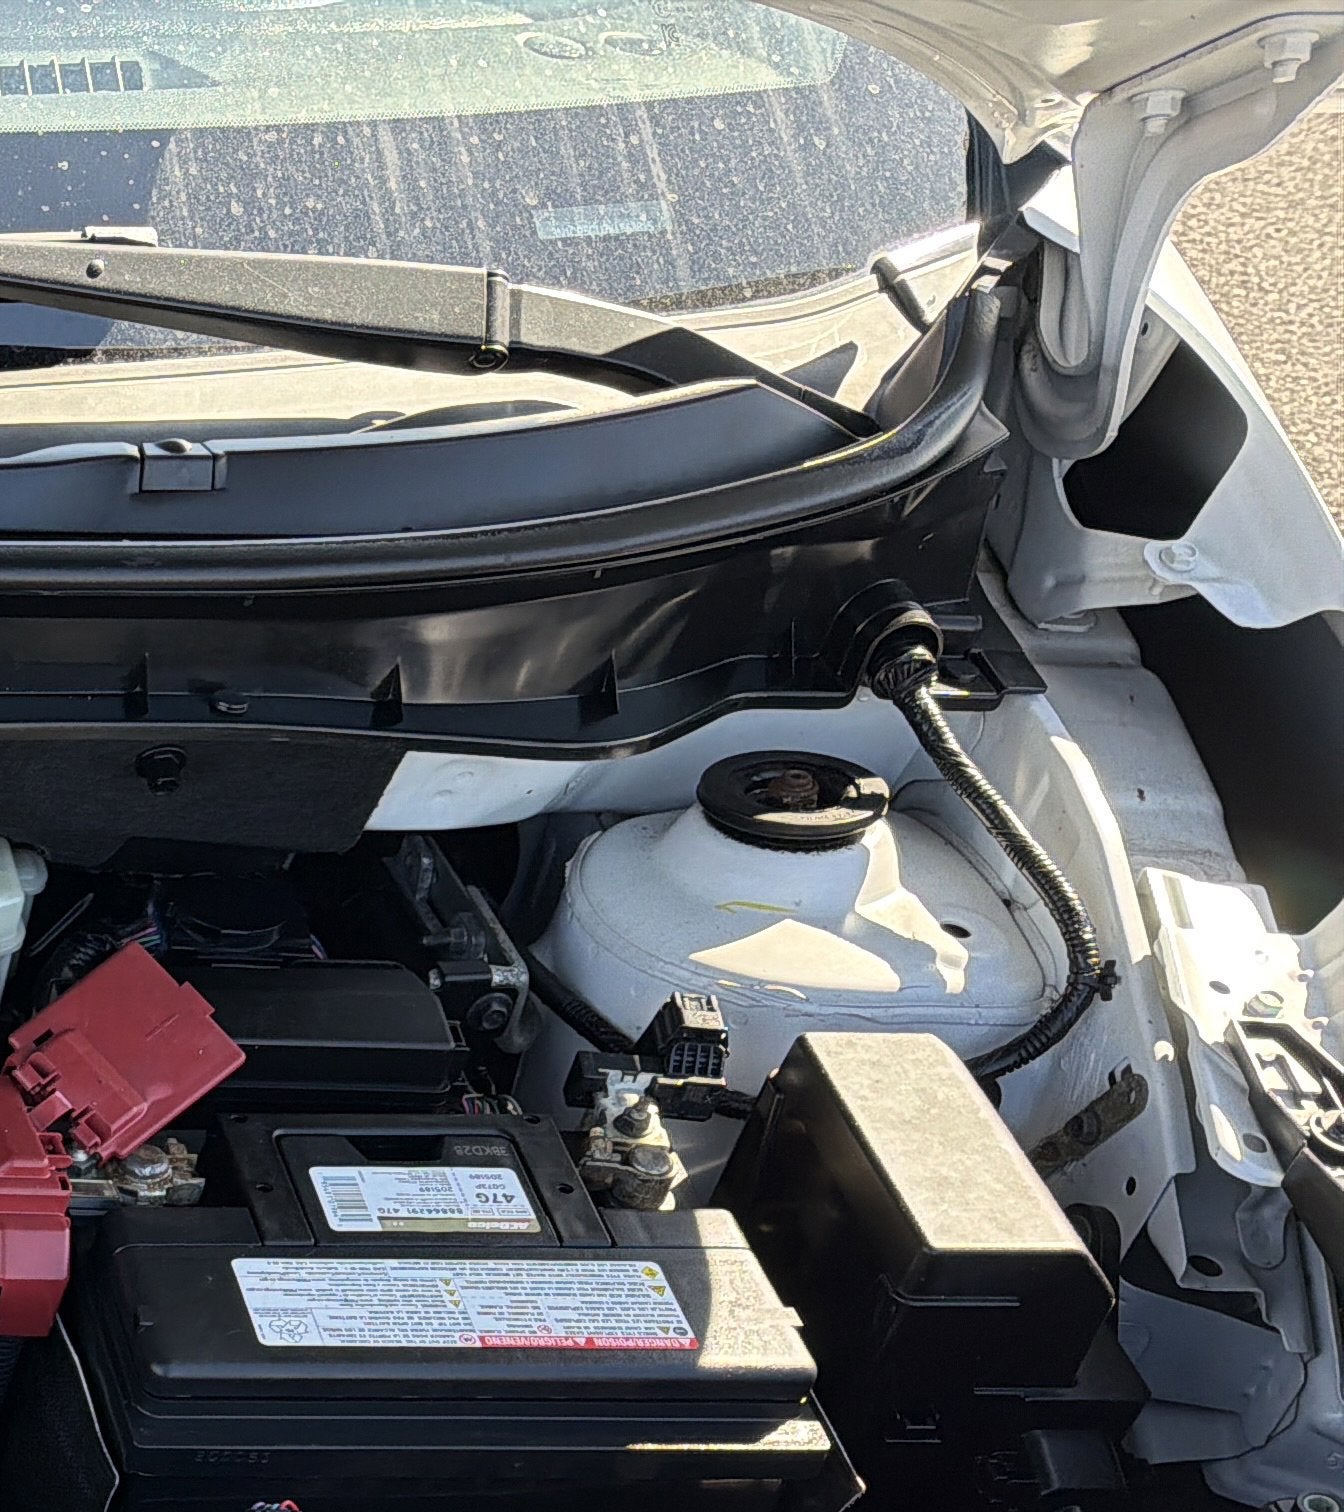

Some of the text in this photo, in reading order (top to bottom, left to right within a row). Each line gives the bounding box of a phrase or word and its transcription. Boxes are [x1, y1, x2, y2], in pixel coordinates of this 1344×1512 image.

[475, 1193, 515, 1203] 47G
[484, 1336, 573, 1346] PELIGRO/VENENO
[594, 1338, 680, 1347] DANGER/POISON
